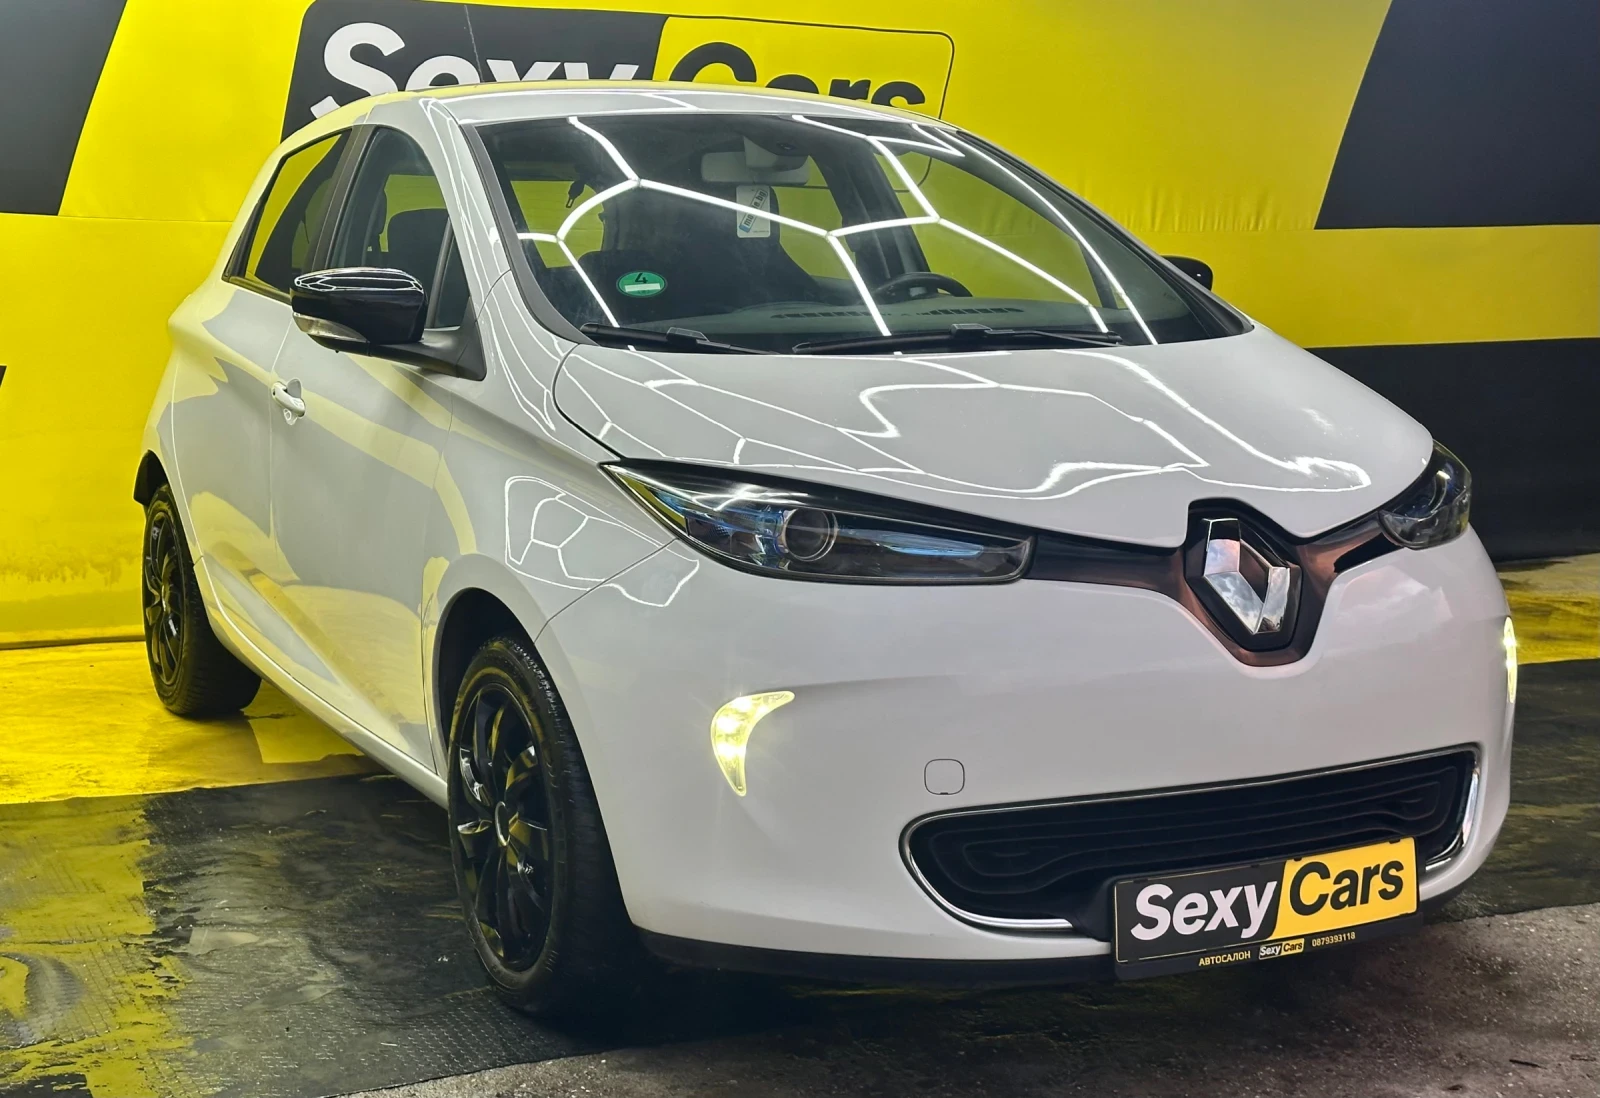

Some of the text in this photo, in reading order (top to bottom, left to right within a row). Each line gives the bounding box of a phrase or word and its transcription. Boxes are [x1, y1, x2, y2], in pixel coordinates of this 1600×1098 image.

[635, 272, 648, 284] 4
[1131, 860, 1404, 941] Sexy Cars
[1199, 932, 1356, 966] АВТОСАЛОН Sexy Cars 0879393118
